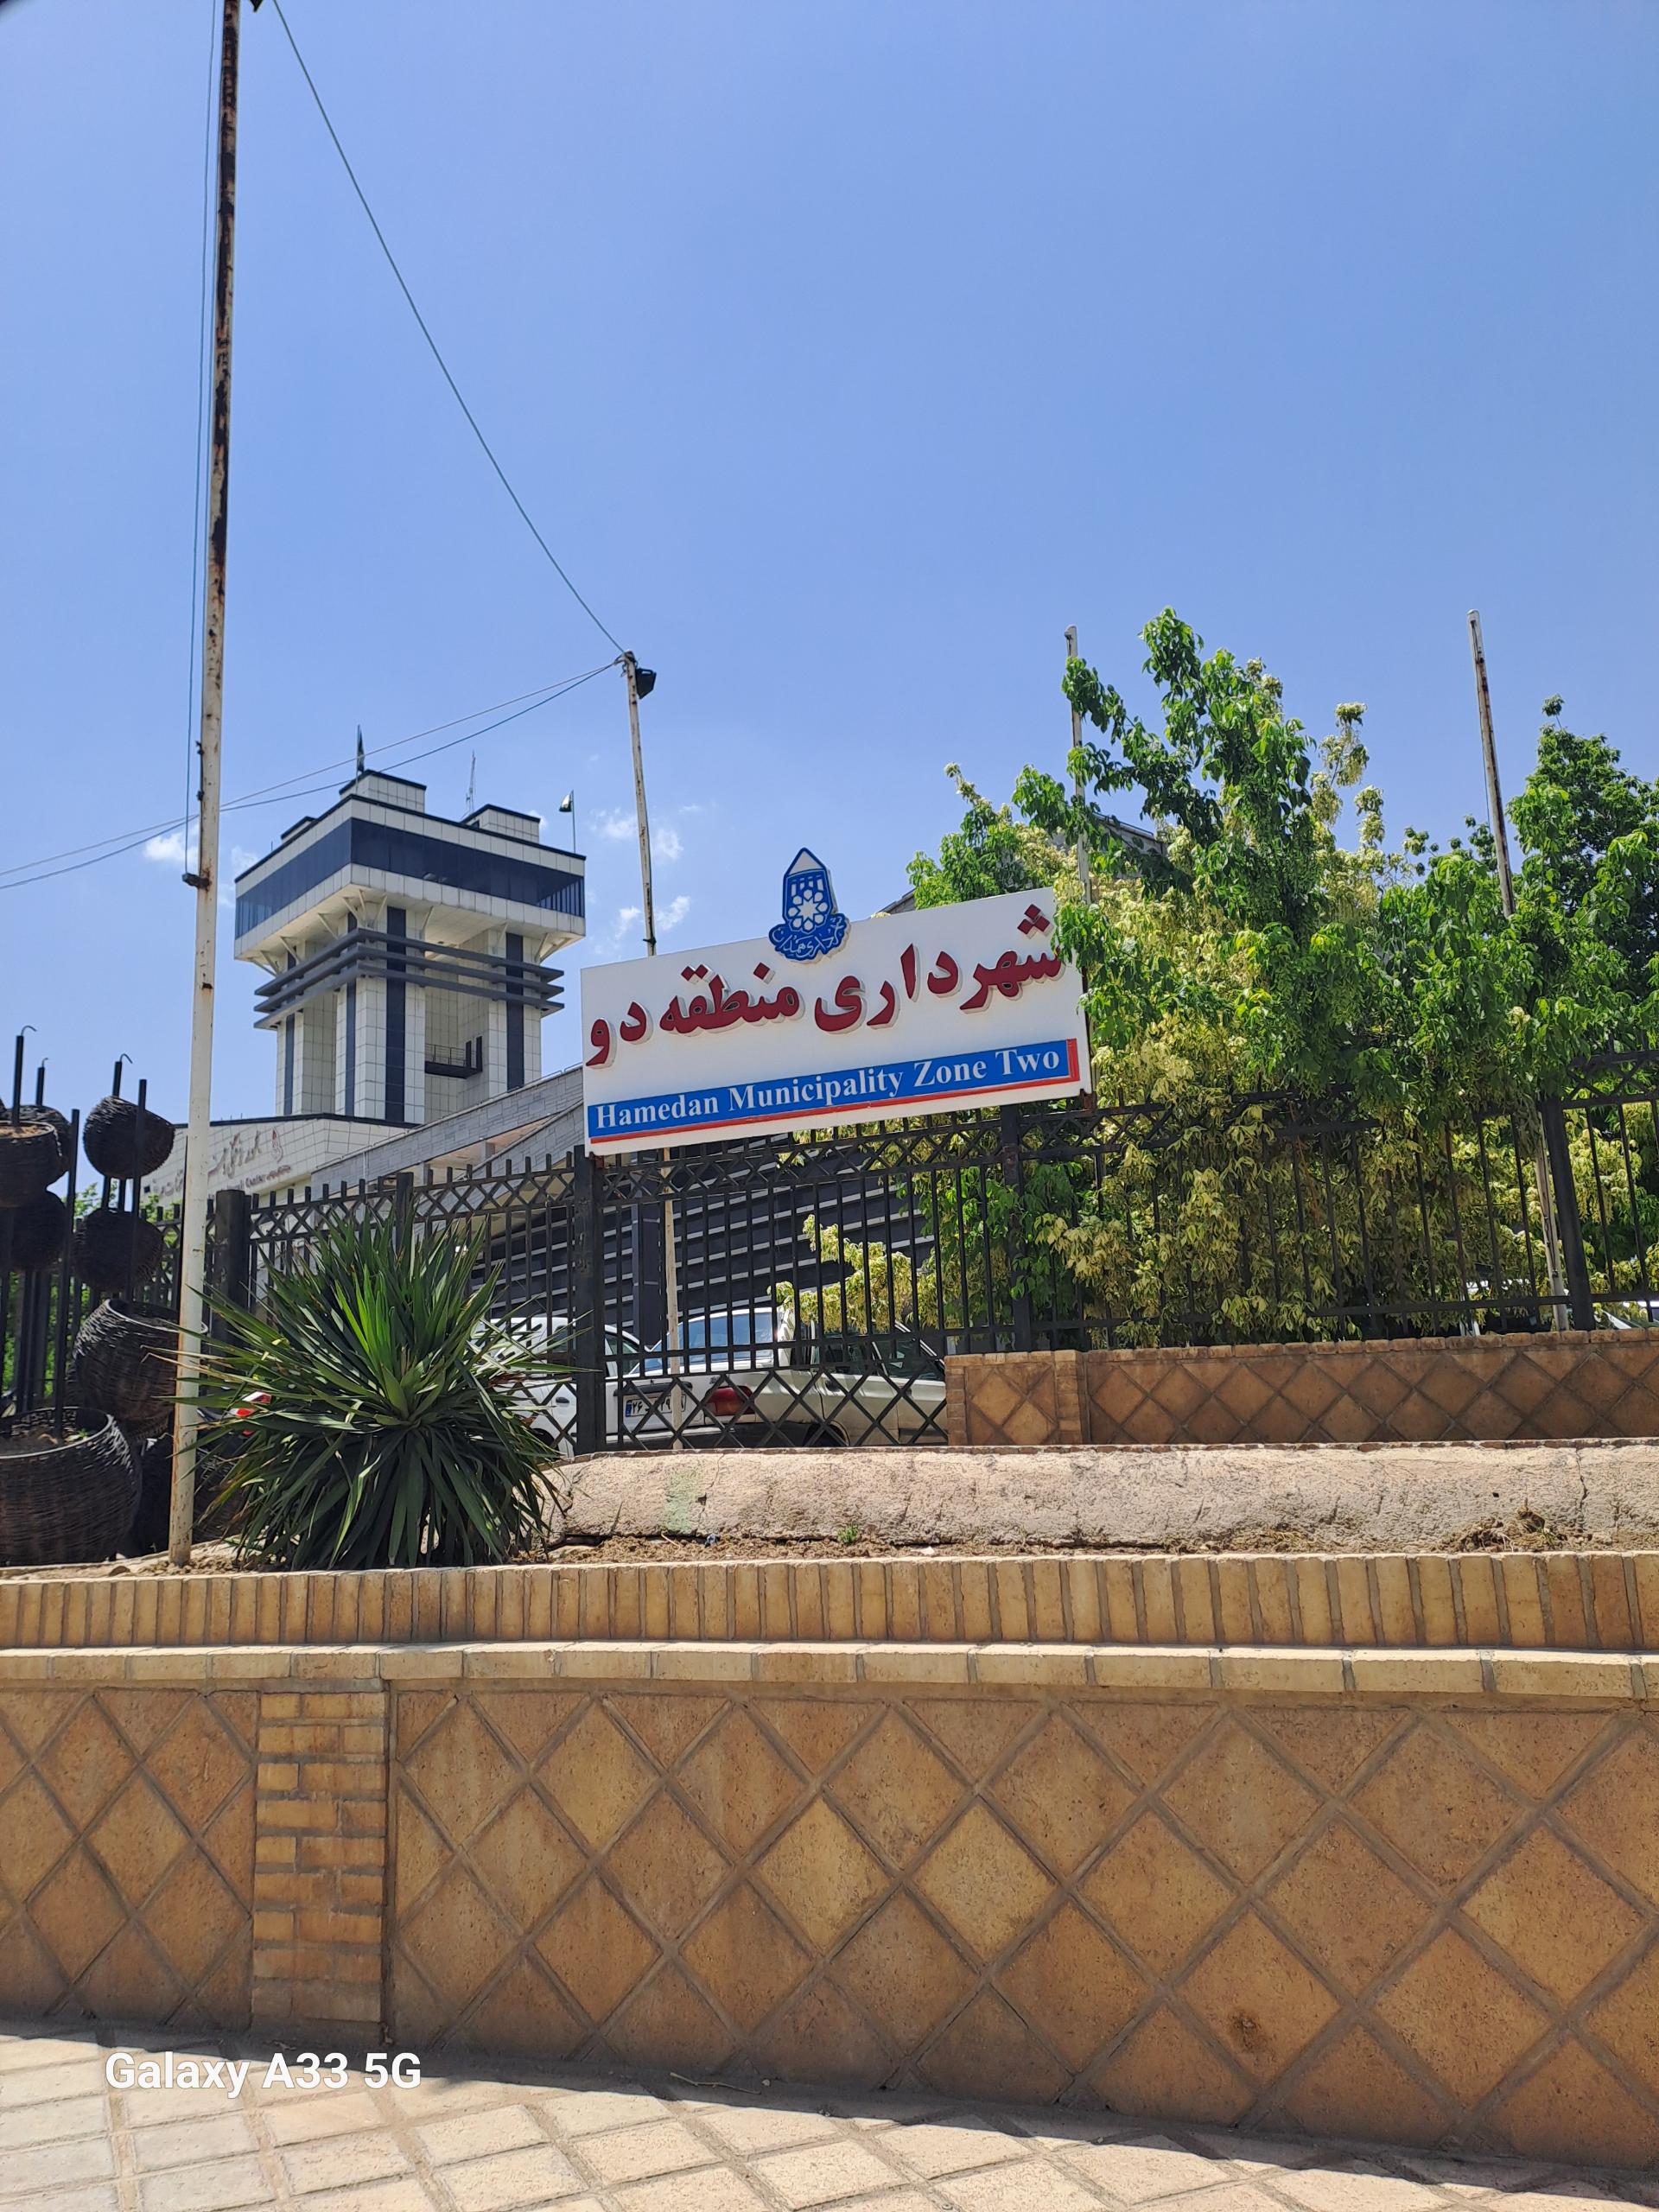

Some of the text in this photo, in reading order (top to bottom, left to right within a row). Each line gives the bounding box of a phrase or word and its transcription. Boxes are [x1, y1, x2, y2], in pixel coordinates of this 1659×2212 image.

[585, 903, 1063, 1067] شهرداری منطقه دو
[596, 1048, 1060, 1129] Hamedan Municipality Zone Two
